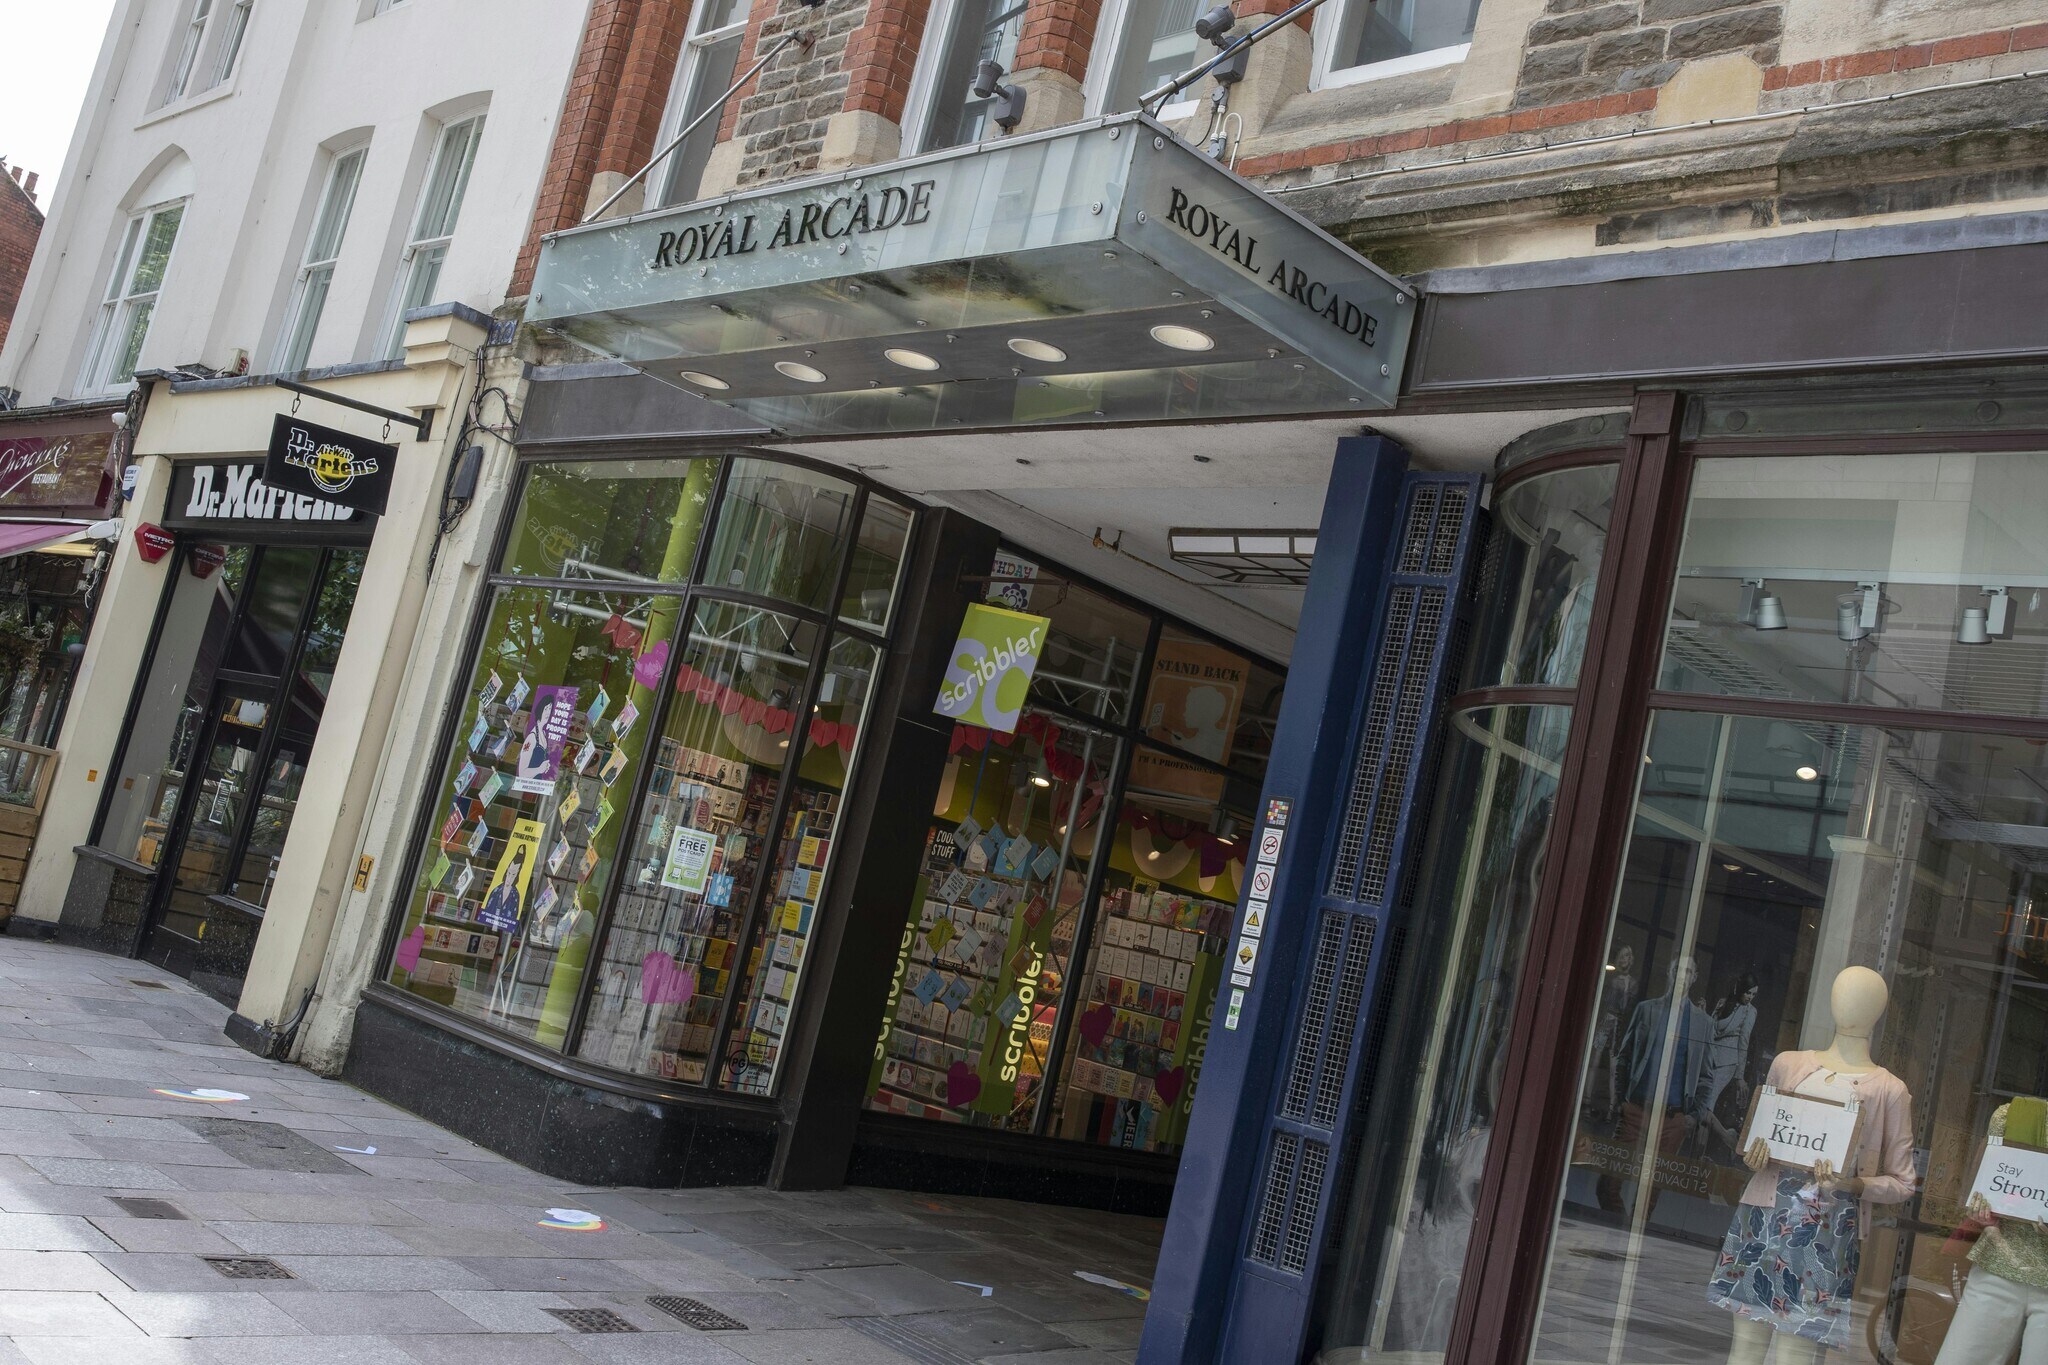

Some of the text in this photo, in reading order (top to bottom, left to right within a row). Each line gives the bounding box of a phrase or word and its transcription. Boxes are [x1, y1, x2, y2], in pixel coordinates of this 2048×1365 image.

[651, 179, 935, 270] ROYAL ARCADE
[1165, 186, 1378, 348] ROYAL ARCADE
[284, 444, 379, 477] Martens
[144, 532, 175, 545] METRO
[941, 626, 1040, 711] scribbler
[1156, 659, 1241, 682] STAND BACK
[556, 700, 572, 711] HOPE
[550, 716, 561, 725] DAY
[554, 709, 570, 719] YOUR
[545, 723, 568, 736] PROPER
[679, 838, 707, 854] FREE
[931, 844, 956, 859] STUFF
[731, 1058, 746, 1069] PG
[1775, 1108, 1793, 1122] Be
[1768, 1123, 1828, 1152] Kind
[1996, 1162, 2024, 1178] Stay
